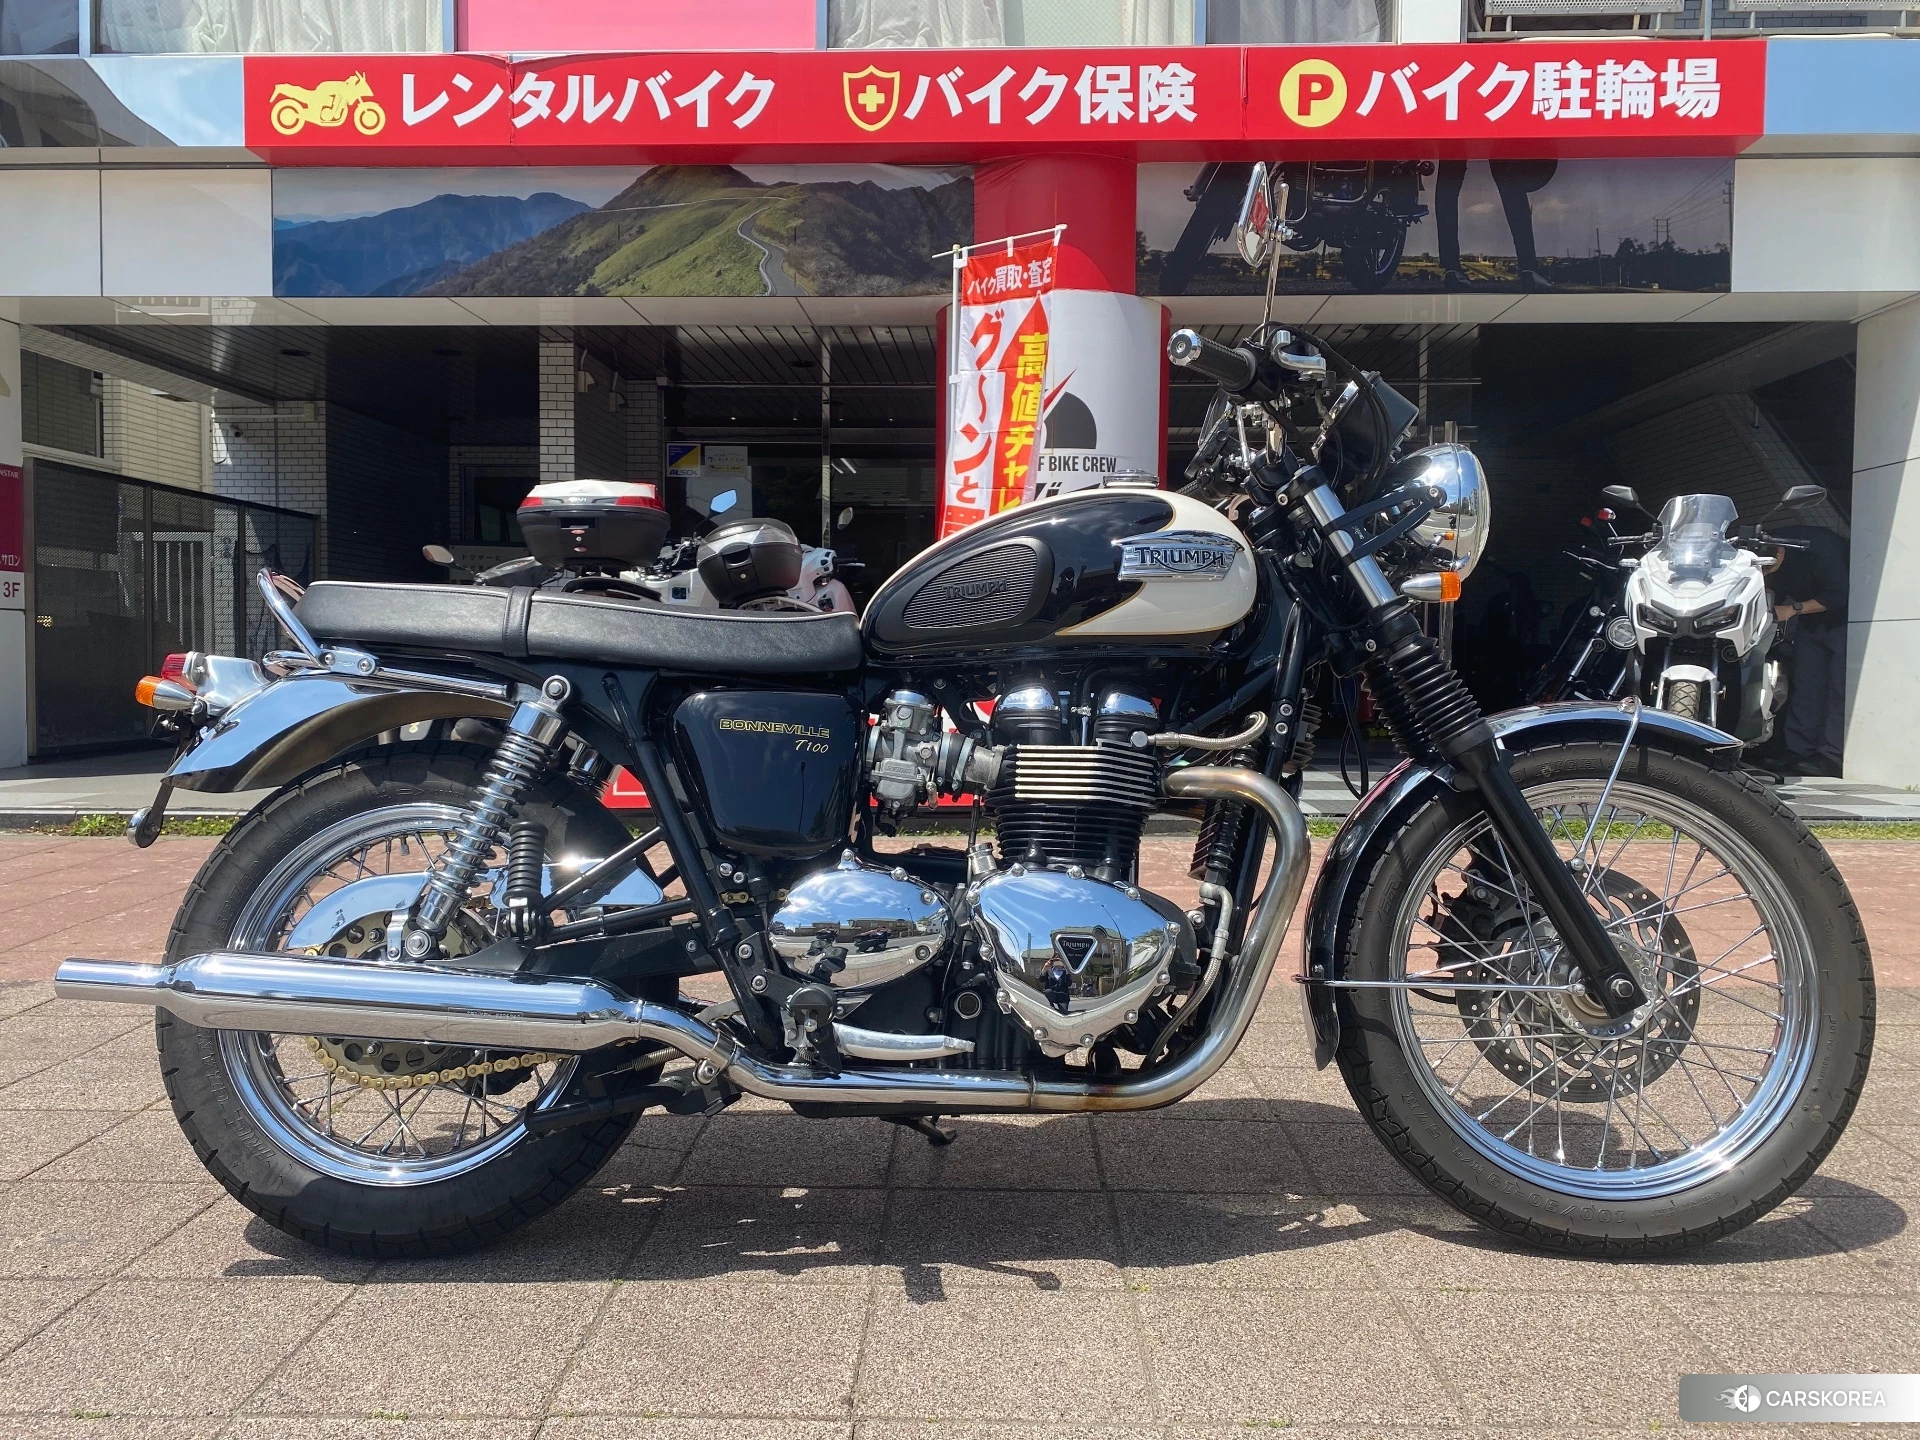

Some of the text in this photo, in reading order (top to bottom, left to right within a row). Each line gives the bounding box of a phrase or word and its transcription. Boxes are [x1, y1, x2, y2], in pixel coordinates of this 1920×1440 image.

[402, 69, 776, 129] レンタルバイク
[902, 62, 1198, 125] バイク保険
[1355, 57, 1722, 122] バイク駐輪場
[1048, 455, 1079, 472] BIKE
[1082, 456, 1117, 473] CREW
[1134, 546, 1226, 571] TRIUMPH
[3, 581, 21, 598] 3F
[941, 578, 1009, 600] TRIUMPH
[719, 718, 830, 739] BONNEVILLE
[794, 739, 829, 754] T100
[1061, 940, 1090, 950] TRIUMPH
